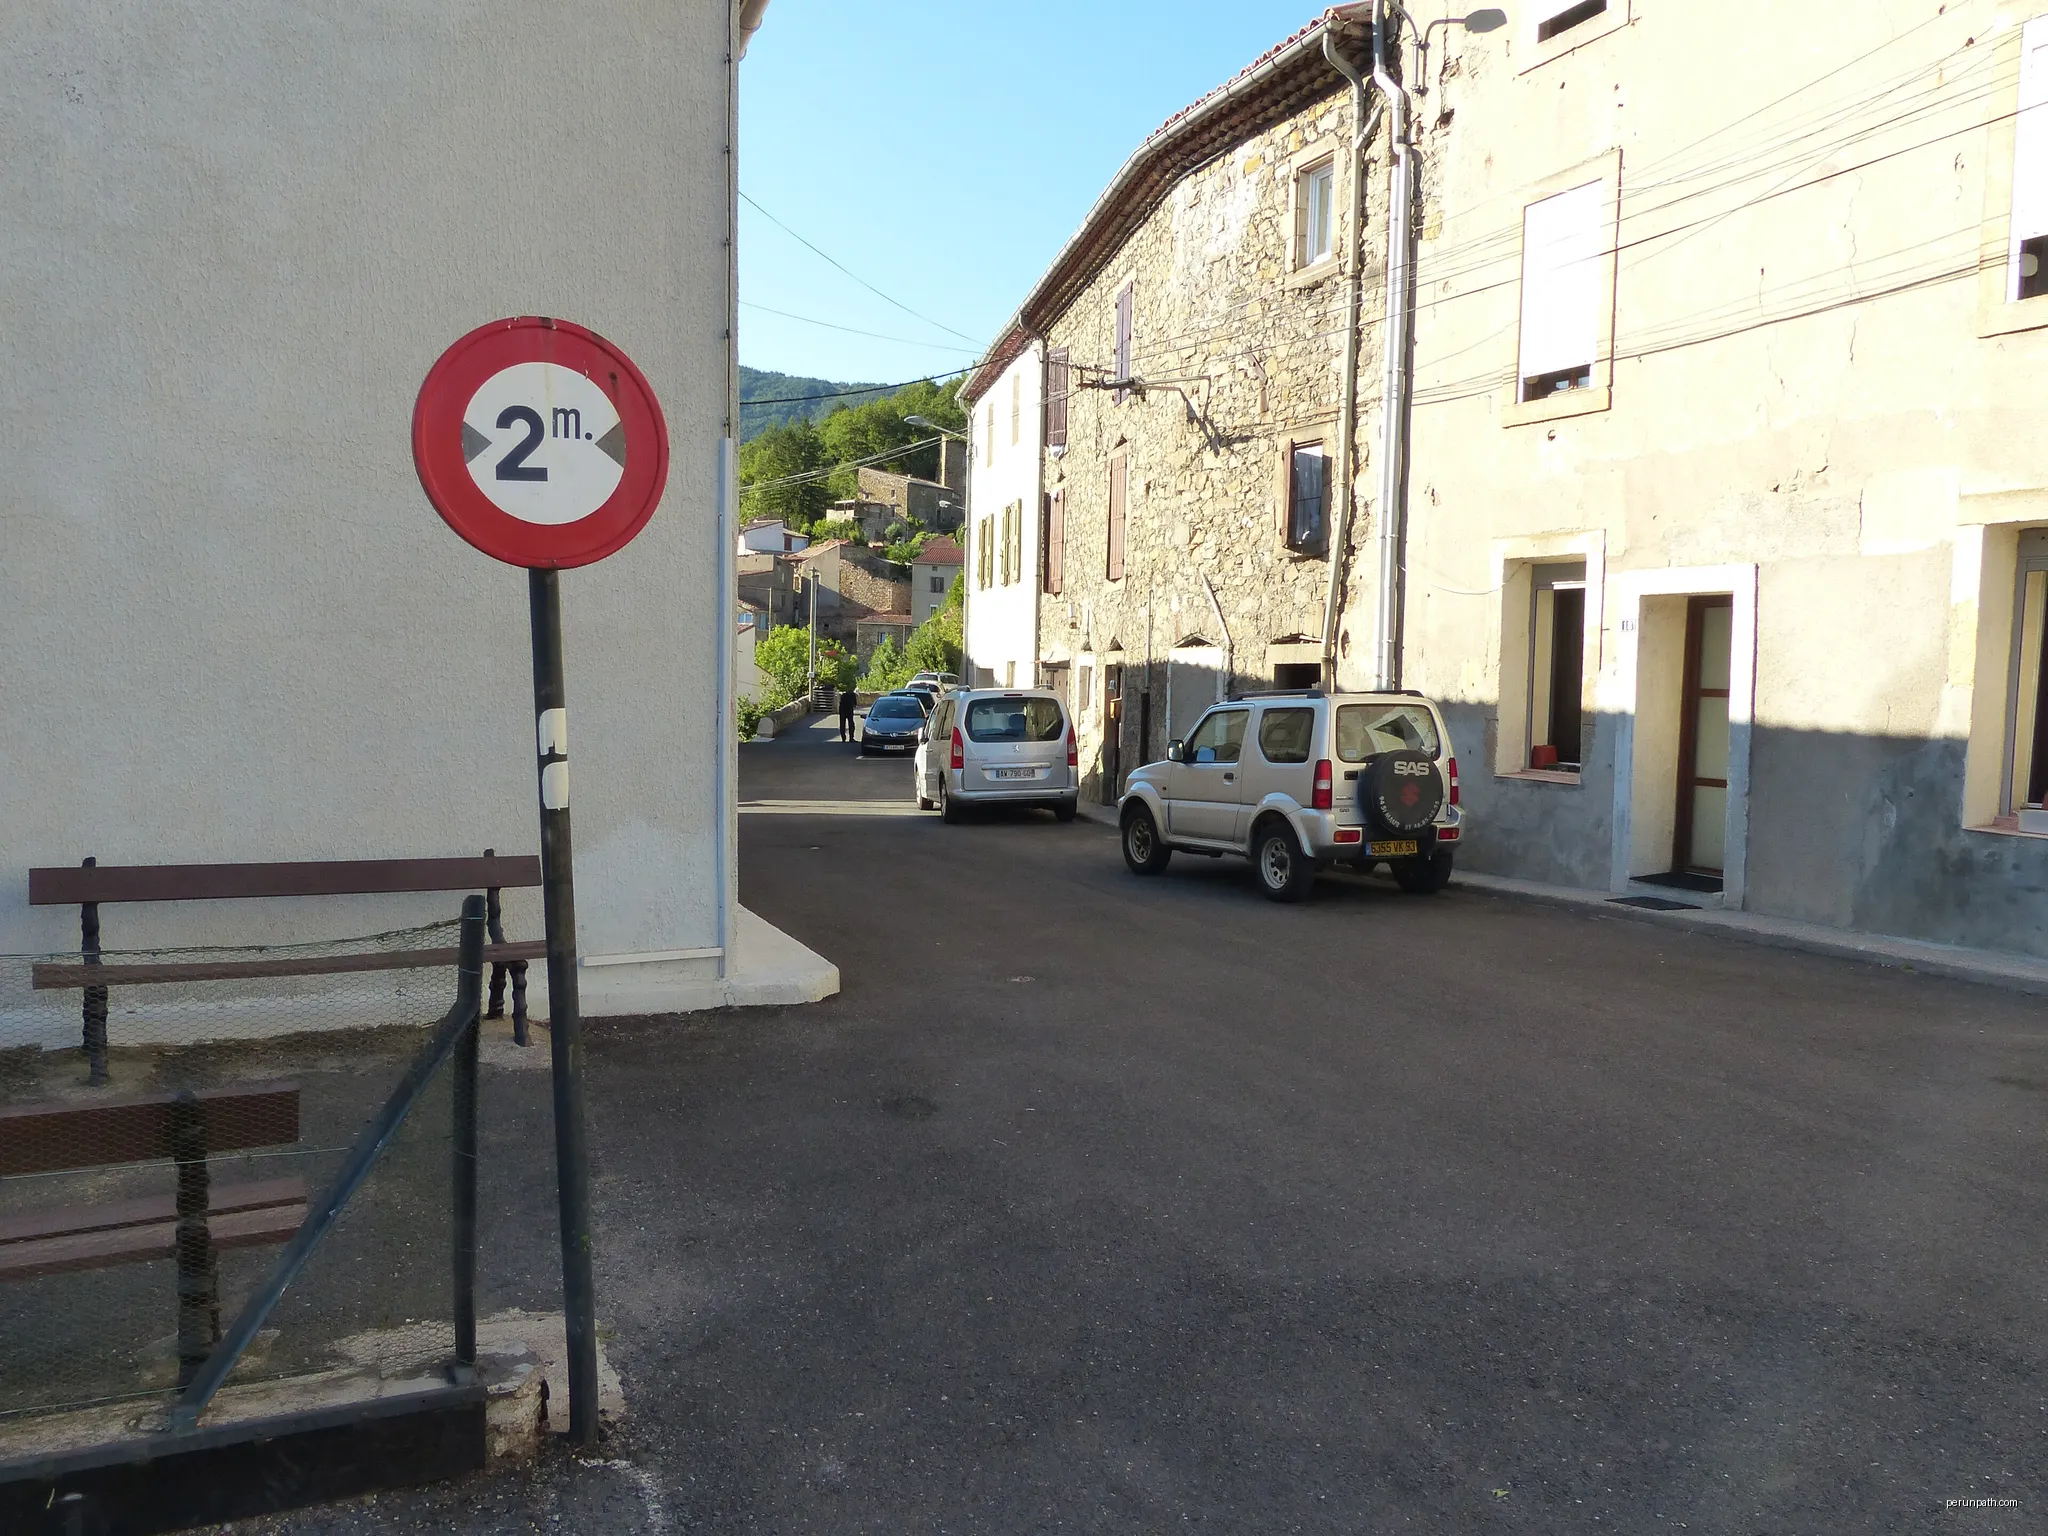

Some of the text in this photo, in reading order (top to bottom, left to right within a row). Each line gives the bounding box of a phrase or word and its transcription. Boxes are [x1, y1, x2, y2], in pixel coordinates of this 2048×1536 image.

[495, 404, 548, 482] 2
[1393, 760, 1430, 777] SAS
[1370, 840, 1416, 854] 6355 VK 93
